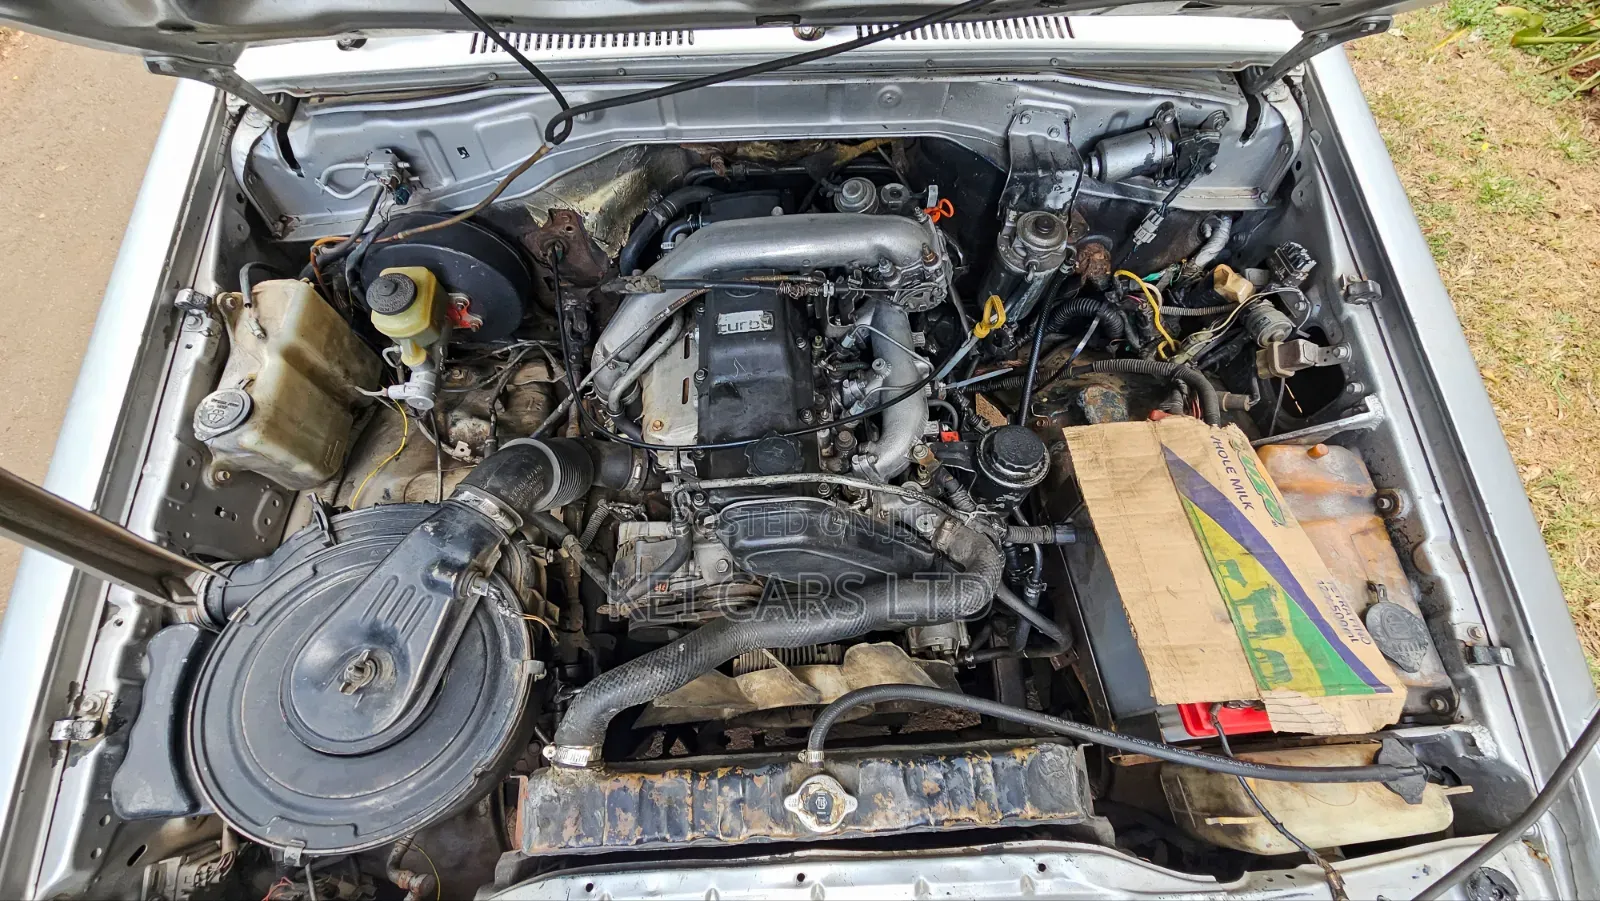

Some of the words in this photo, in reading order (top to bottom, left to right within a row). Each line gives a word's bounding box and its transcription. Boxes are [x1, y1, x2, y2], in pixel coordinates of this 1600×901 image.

[717, 319, 768, 333] turb
[1229, 478, 1255, 511] MILK
[1044, 714, 1062, 724] FUEL
